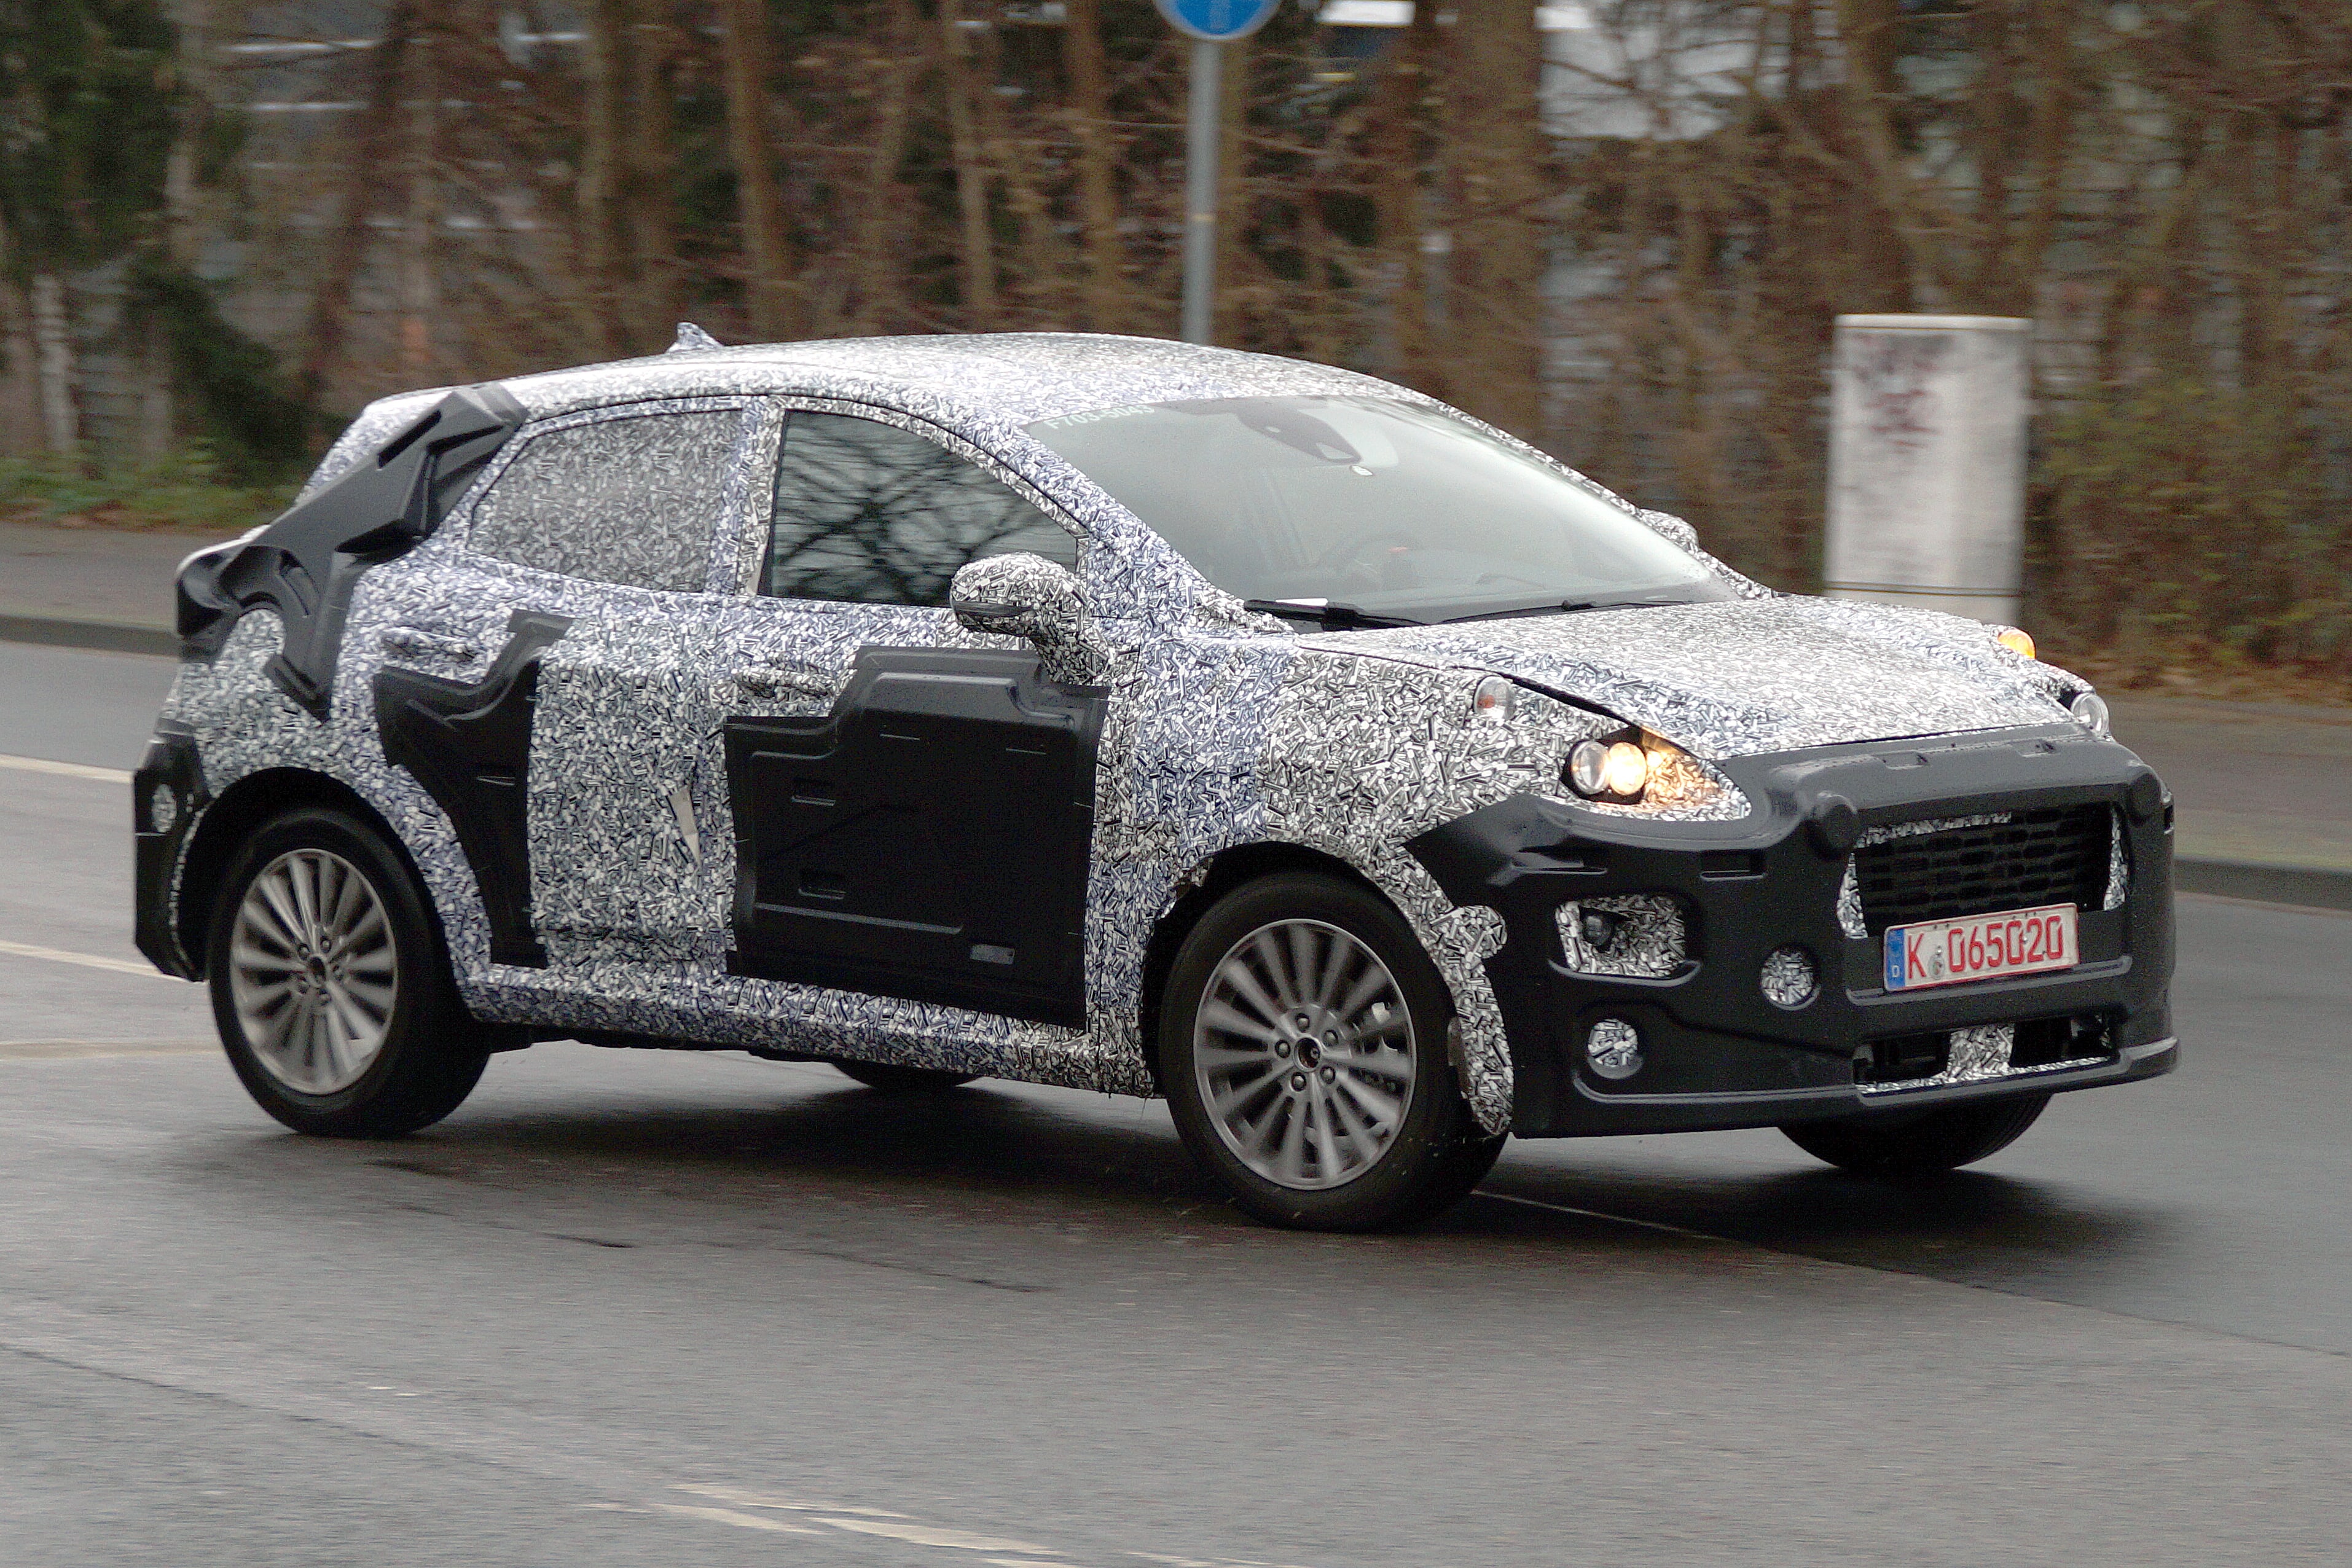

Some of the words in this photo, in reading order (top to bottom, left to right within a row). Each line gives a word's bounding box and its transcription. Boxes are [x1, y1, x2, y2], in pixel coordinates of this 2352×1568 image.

[1907, 933, 1926, 979] K
[1947, 915, 2063, 973] 065020
[1892, 965, 1900, 978] D
